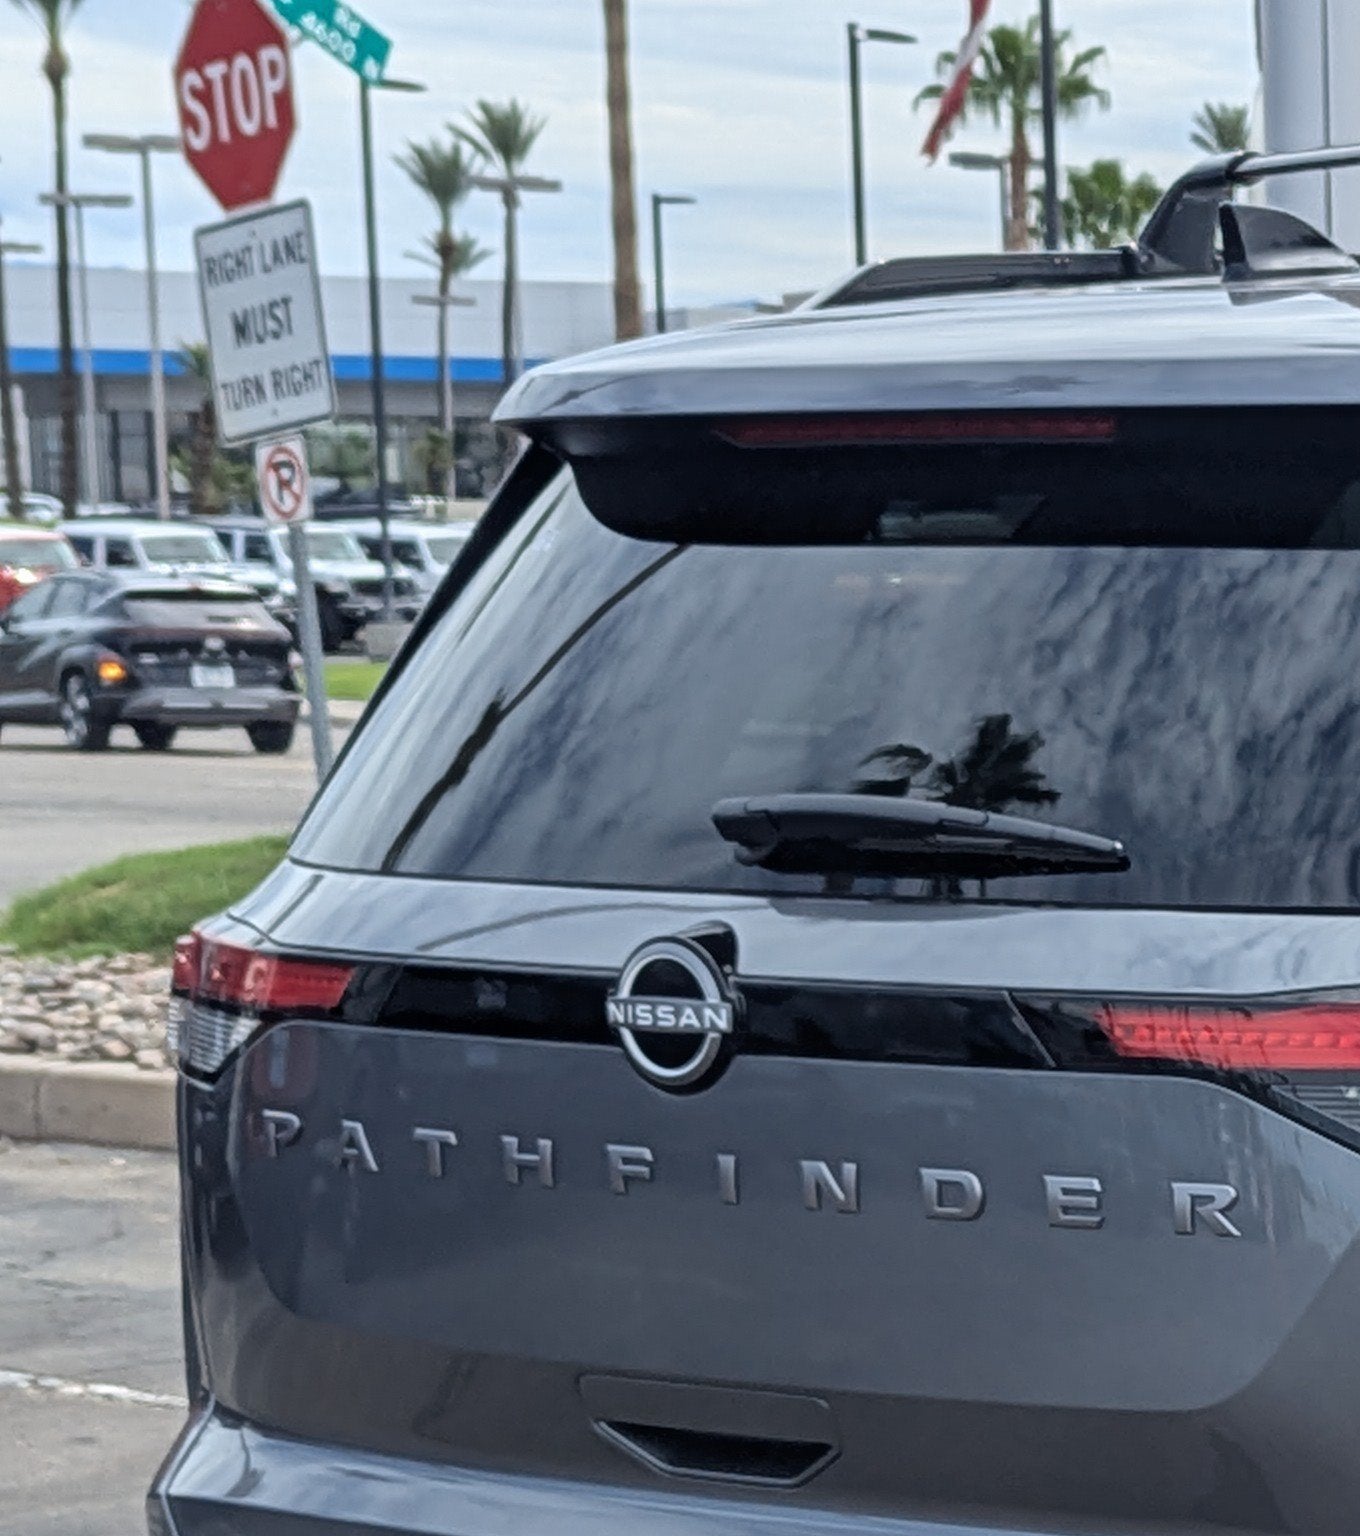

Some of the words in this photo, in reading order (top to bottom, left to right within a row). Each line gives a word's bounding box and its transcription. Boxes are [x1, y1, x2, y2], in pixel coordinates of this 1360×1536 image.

[181, 44, 286, 151] STOP
[204, 245, 256, 287] RIGHT
[258, 231, 308, 274] LANE
[231, 297, 294, 348] MUST
[221, 374, 268, 412] TURN
[270, 359, 323, 401] RIGHT
[606, 1001, 728, 1031] NISSAN
[261, 1108, 1243, 1238] PATHFINDER
